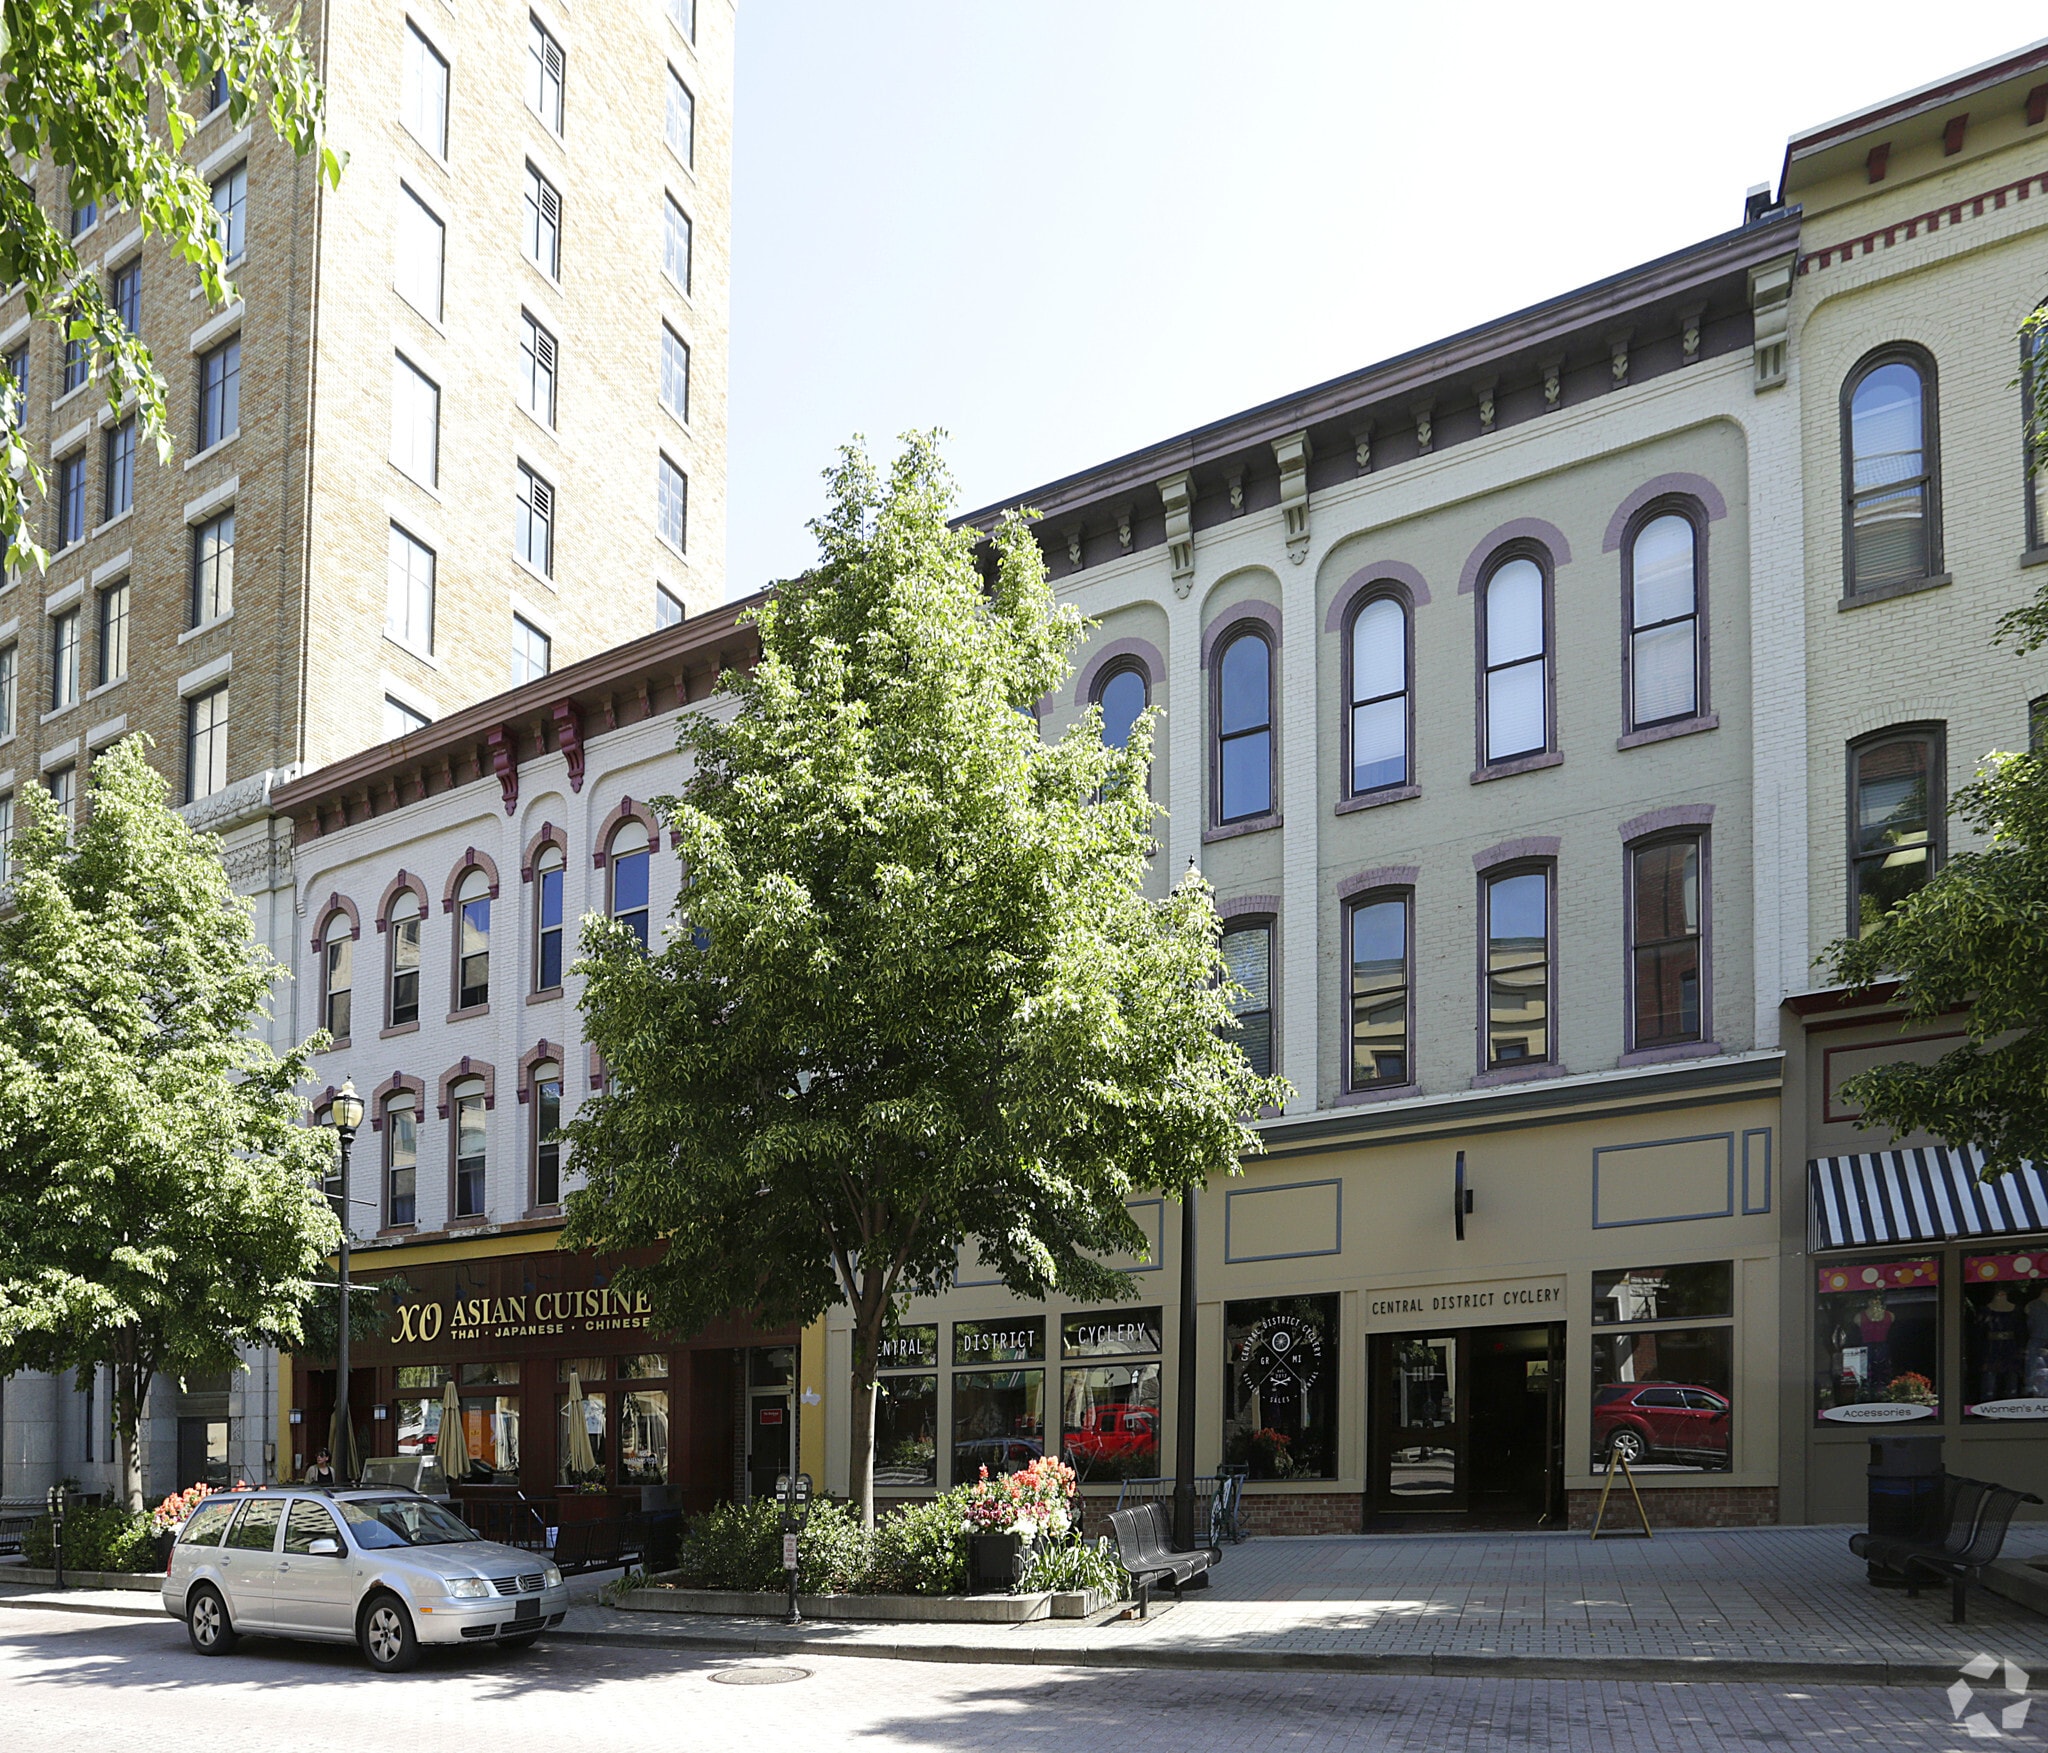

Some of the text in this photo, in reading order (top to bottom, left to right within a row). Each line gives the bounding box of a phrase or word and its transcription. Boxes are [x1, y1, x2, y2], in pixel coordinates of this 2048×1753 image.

[1372, 1288, 1560, 1315] CENTRAL DISTRICT CYCLERY
[391, 1288, 652, 1344] XO ASIAN CUISINE
[451, 1316, 651, 1340] THAI JAPANESE CHINESE
[876, 1322, 1145, 1357] ENTRAL DISTRICT CYCLERY
[1241, 1315, 1322, 1361] CENTRAL DISTRICT CYCLERY
[1260, 1354, 1302, 1365] GR MI
[1843, 1407, 1912, 1418] Accessories
[1980, 1403, 2032, 1415] Women's
